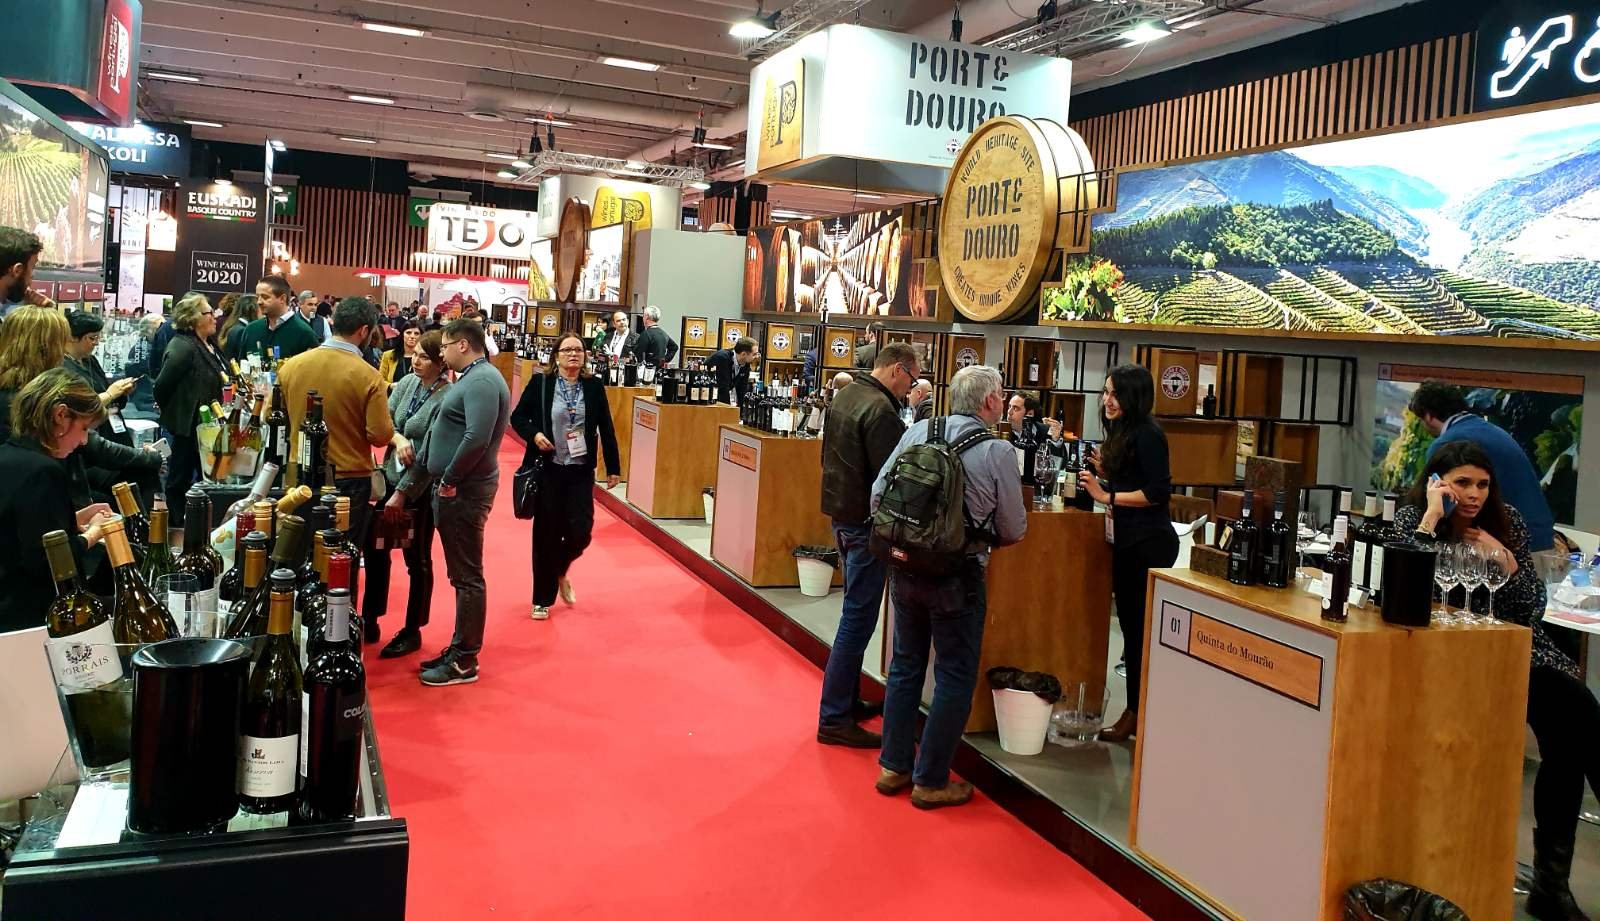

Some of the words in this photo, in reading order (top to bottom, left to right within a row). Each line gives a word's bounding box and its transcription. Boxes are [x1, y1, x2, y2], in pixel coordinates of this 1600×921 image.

[91, 125, 180, 148] ALESA
[1020, 146, 1036, 173] SITE
[187, 205, 217, 215] BASQUE
[218, 208, 257, 217] COUNTRY
[188, 191, 257, 209] EUSKADI
[440, 216, 525, 251] TEJO
[963, 223, 1020, 261] DOURO
[196, 260, 218, 269] WINE
[220, 262, 244, 270] PARIS
[196, 269, 242, 285] 2020
[954, 265, 976, 303] CREATES
[1170, 617, 1181, 635] 01
[1197, 630, 1225, 650] Quinta
[1227, 642, 1238, 656] do
[1239, 646, 1274, 670] Mourão
